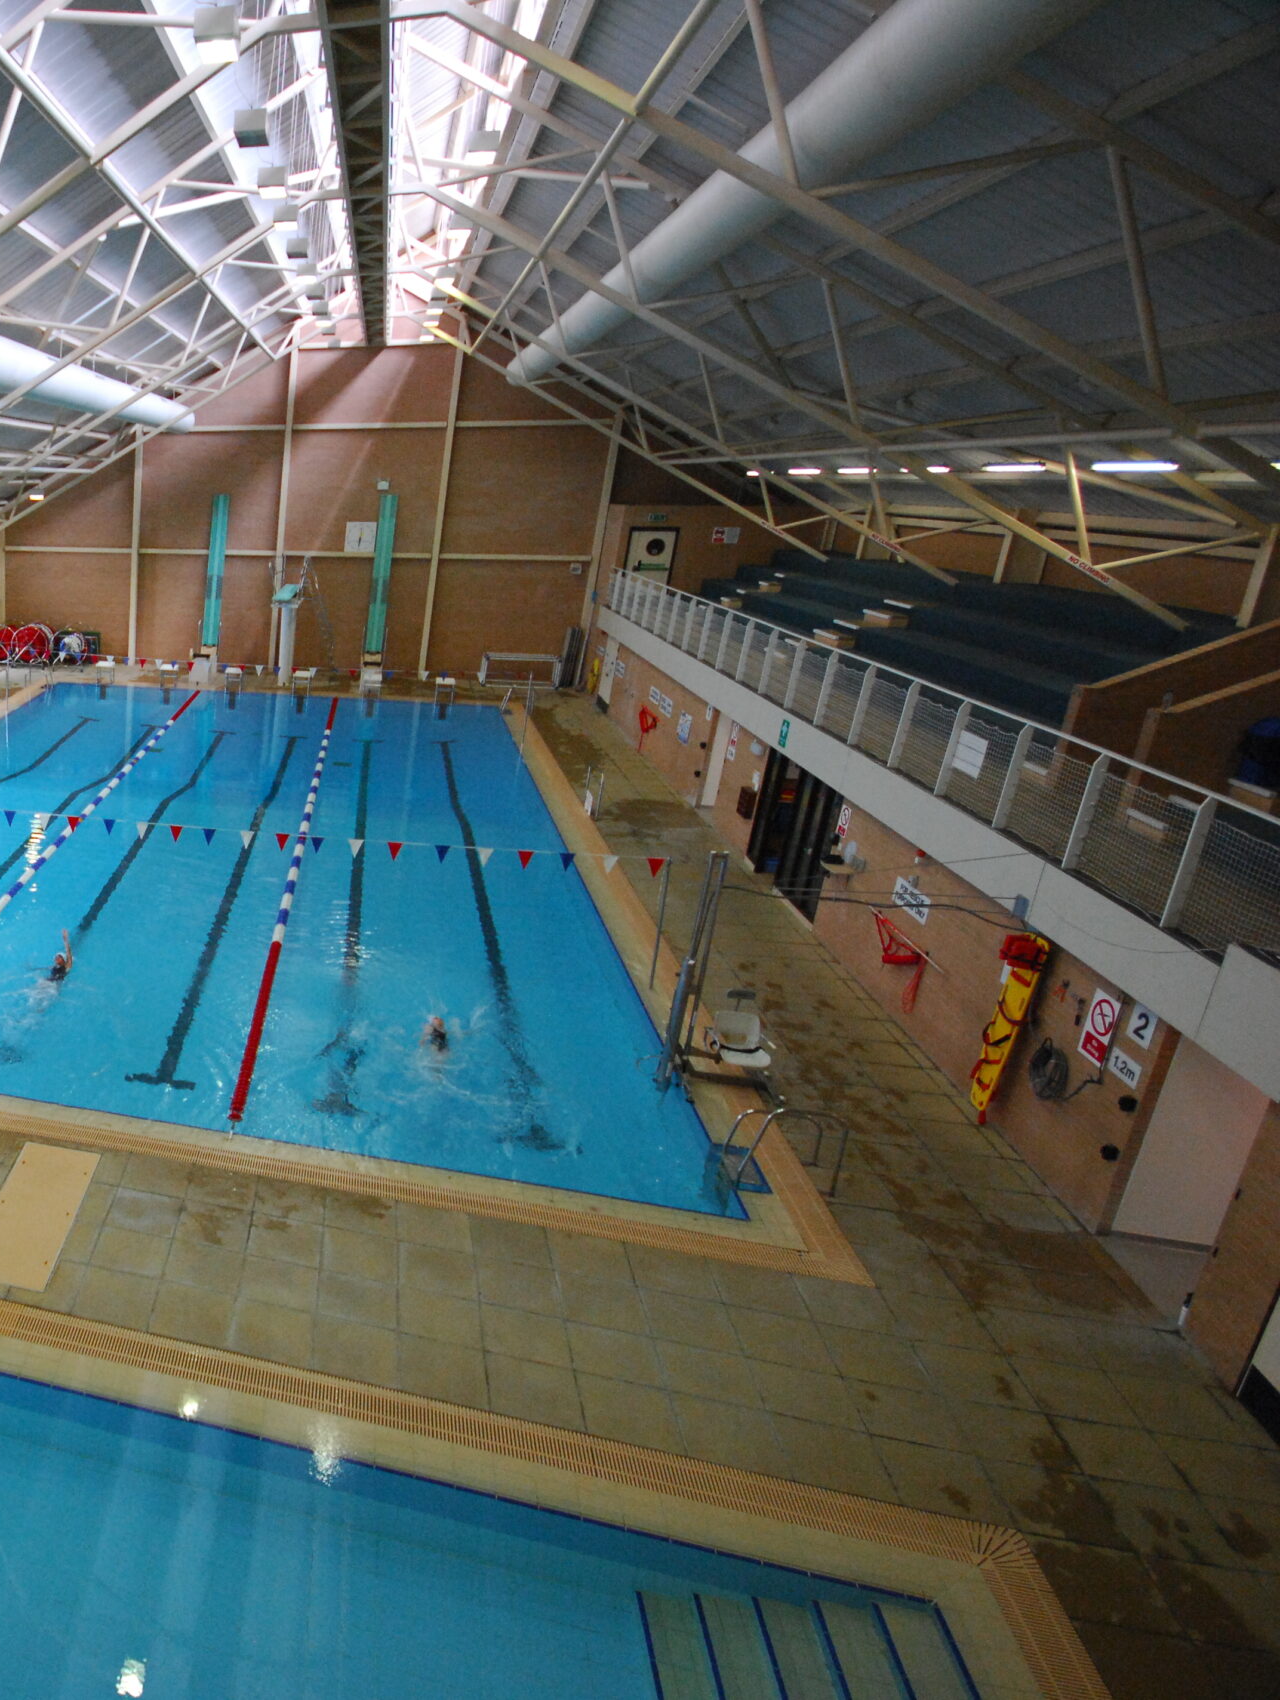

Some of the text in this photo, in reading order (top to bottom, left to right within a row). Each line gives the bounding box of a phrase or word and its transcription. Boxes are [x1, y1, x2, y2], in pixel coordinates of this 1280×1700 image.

[1067, 555, 1079, 565] NO
[1132, 1012, 1150, 1041] 2
[1113, 1055, 1136, 1082] 1.2m
